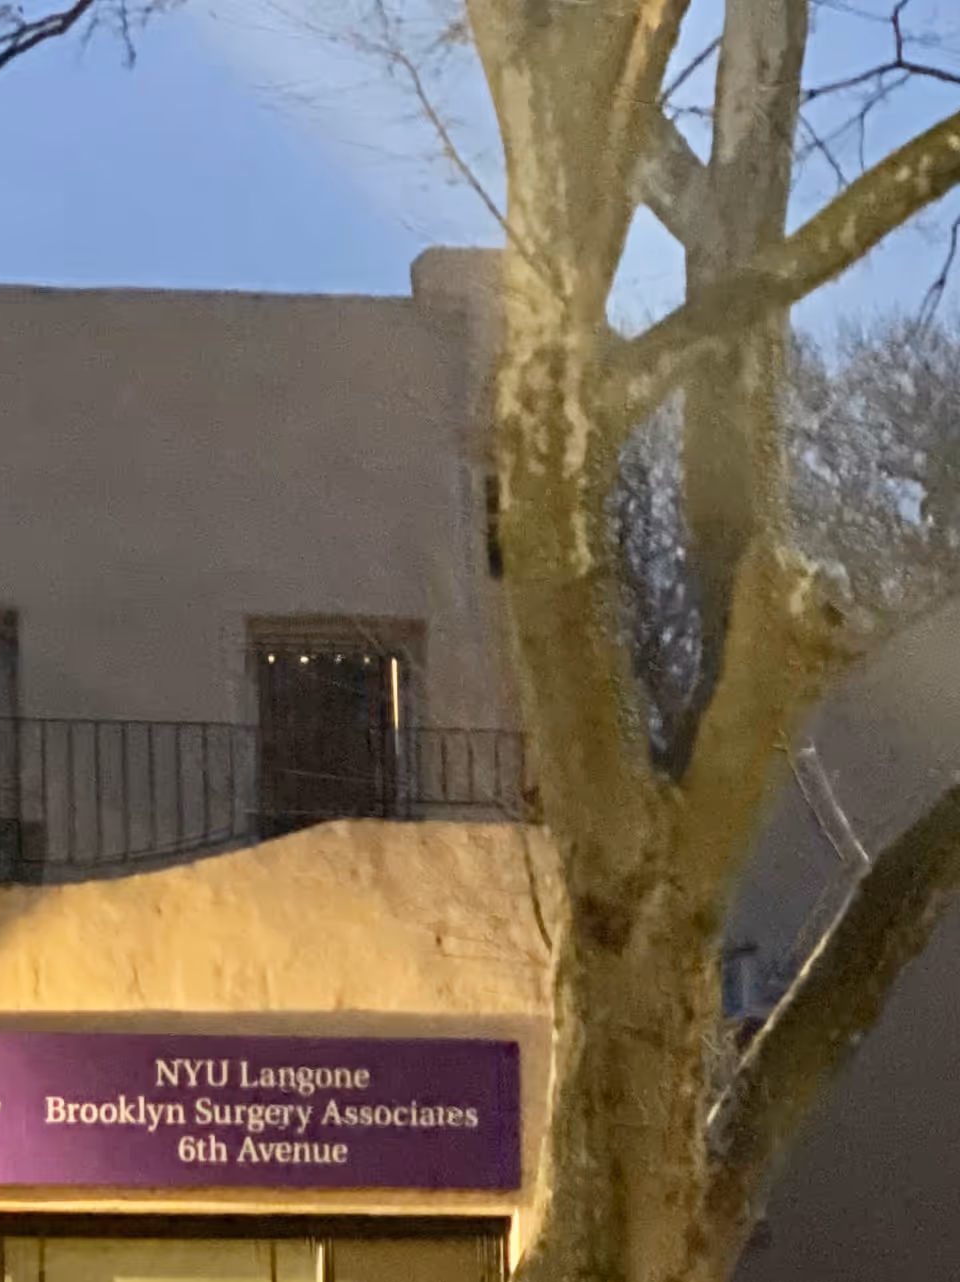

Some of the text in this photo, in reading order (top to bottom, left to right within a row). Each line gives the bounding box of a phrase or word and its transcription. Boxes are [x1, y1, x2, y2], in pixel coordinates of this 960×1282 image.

[155, 1057, 370, 1096] NYU Langone
[45, 1094, 479, 1133] Brooklyn Surgery Associates
[177, 1134, 349, 1163] 6th Avenue
